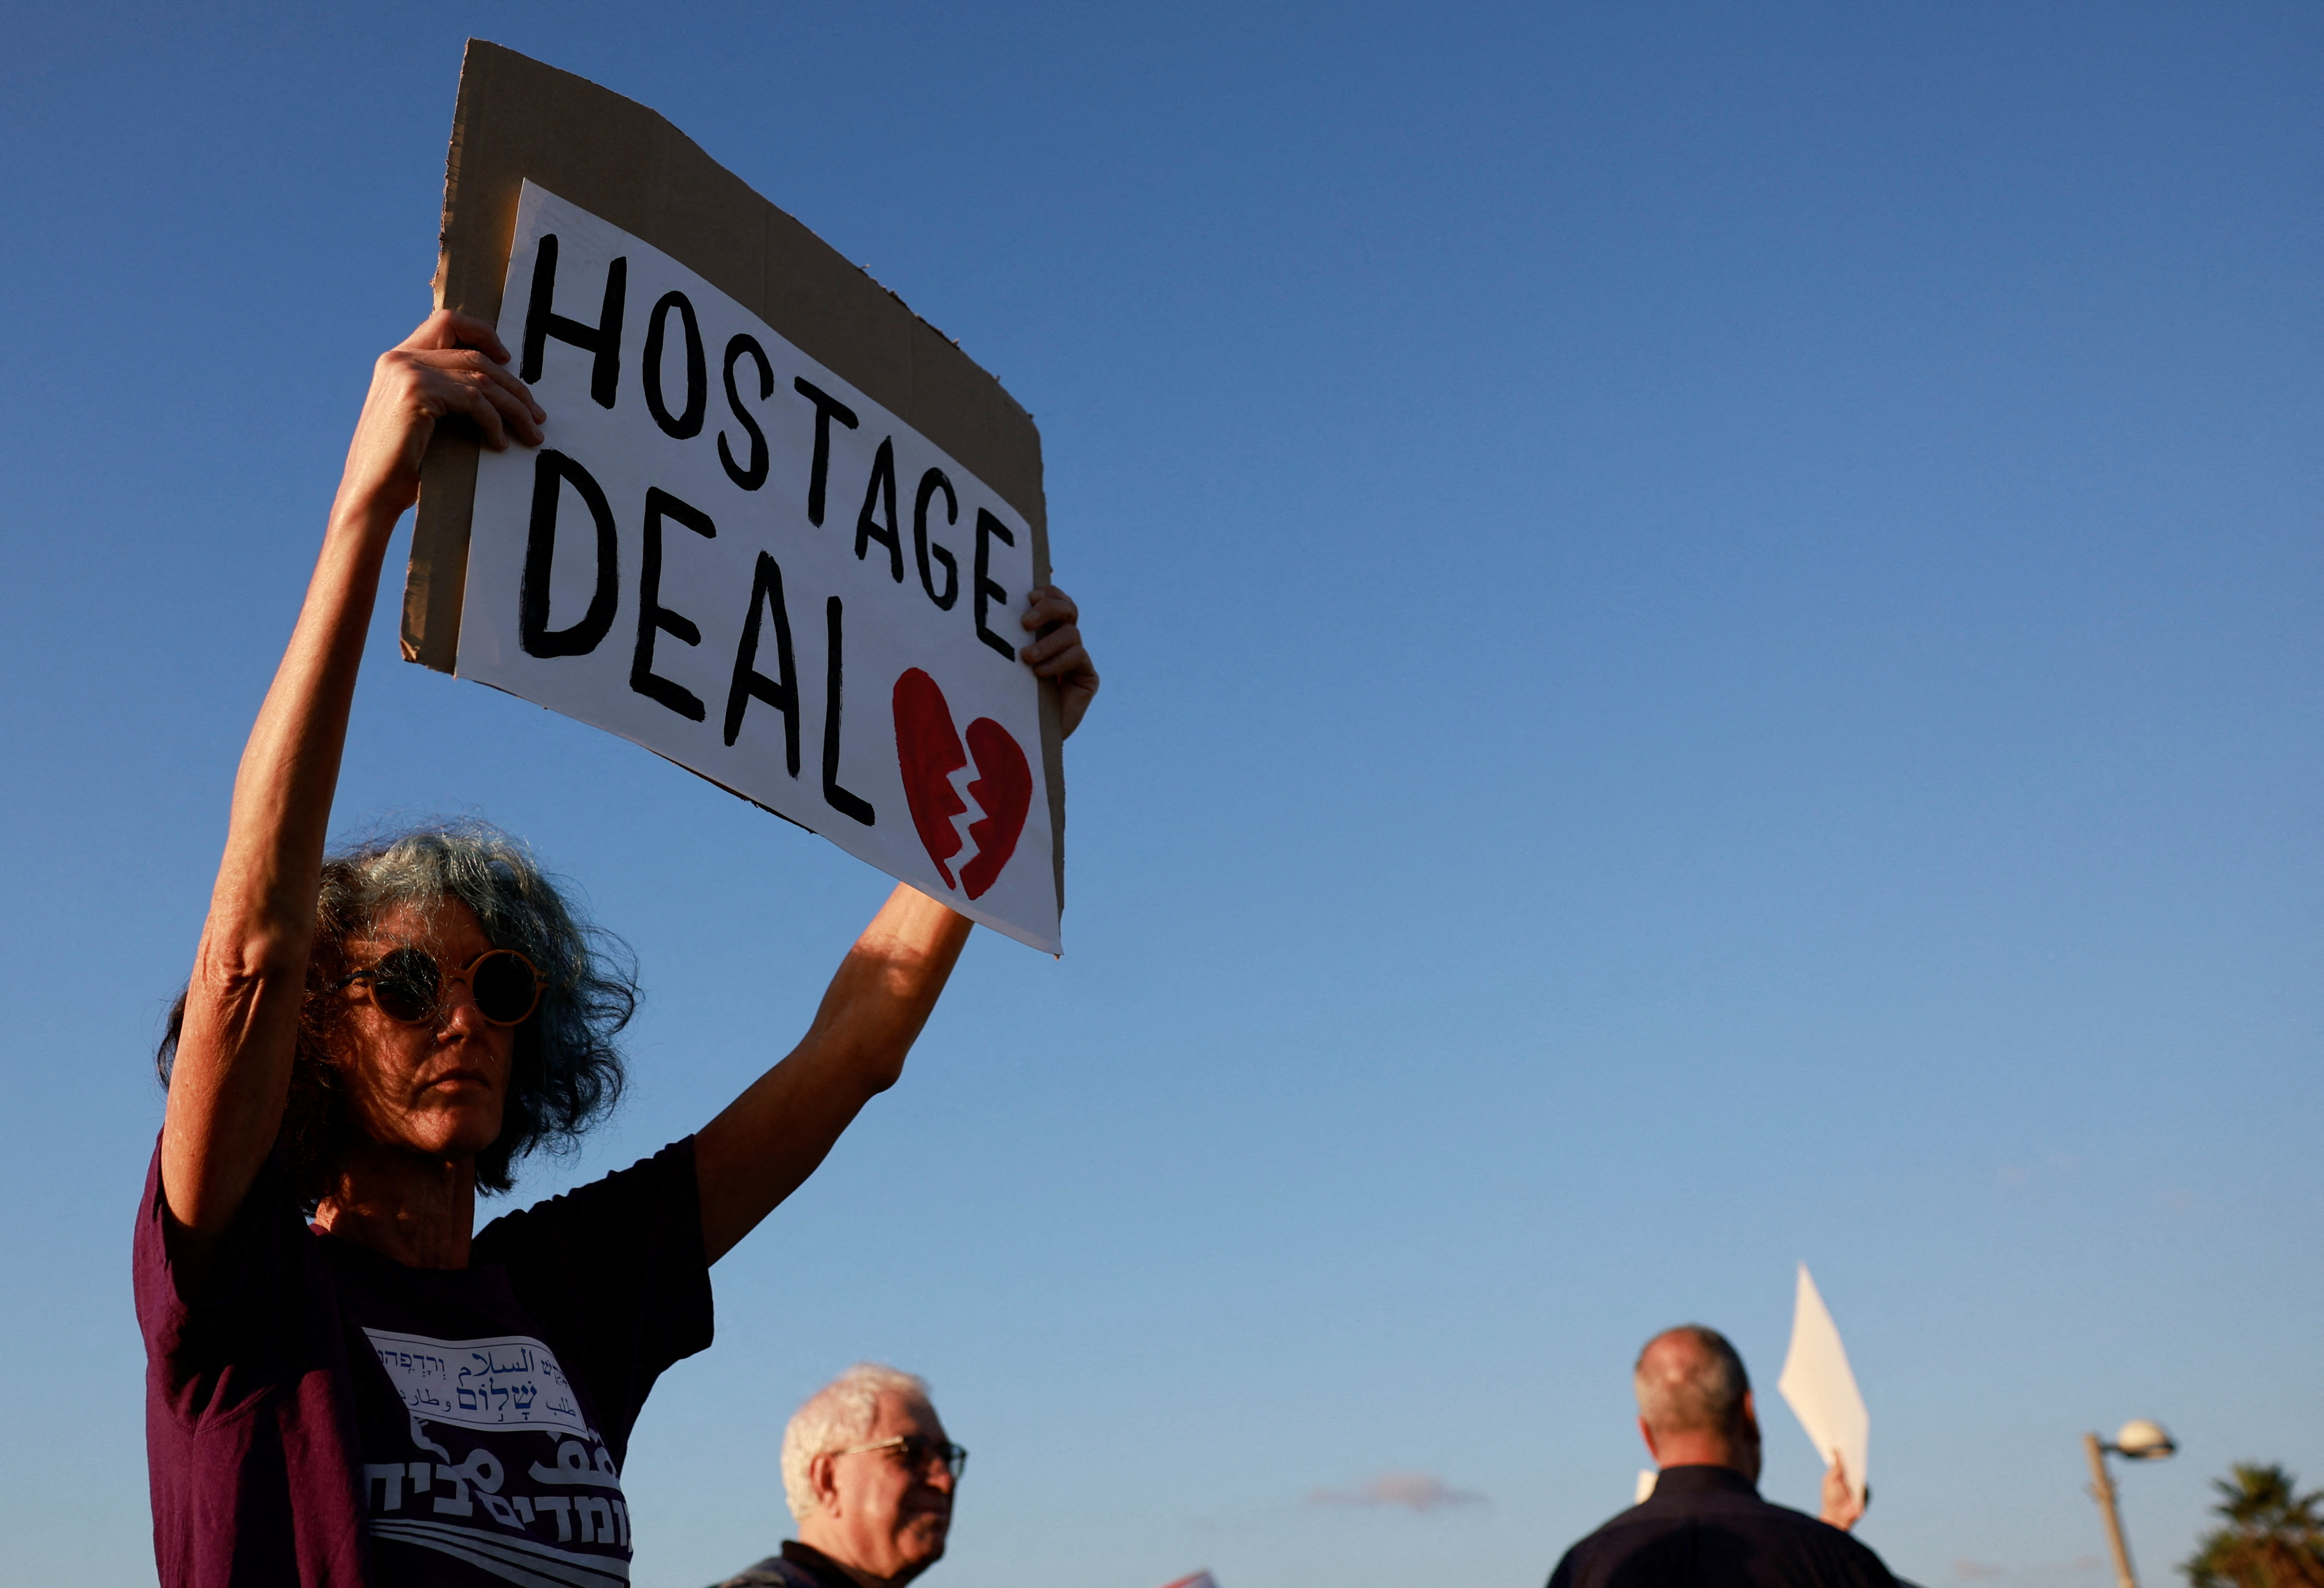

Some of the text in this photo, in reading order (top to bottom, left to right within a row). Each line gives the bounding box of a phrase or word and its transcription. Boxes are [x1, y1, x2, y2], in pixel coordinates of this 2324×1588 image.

[520, 233, 1015, 661] HOSTAGE
[518, 448, 876, 827] DEAL
[457, 1347, 534, 1386] السلام
